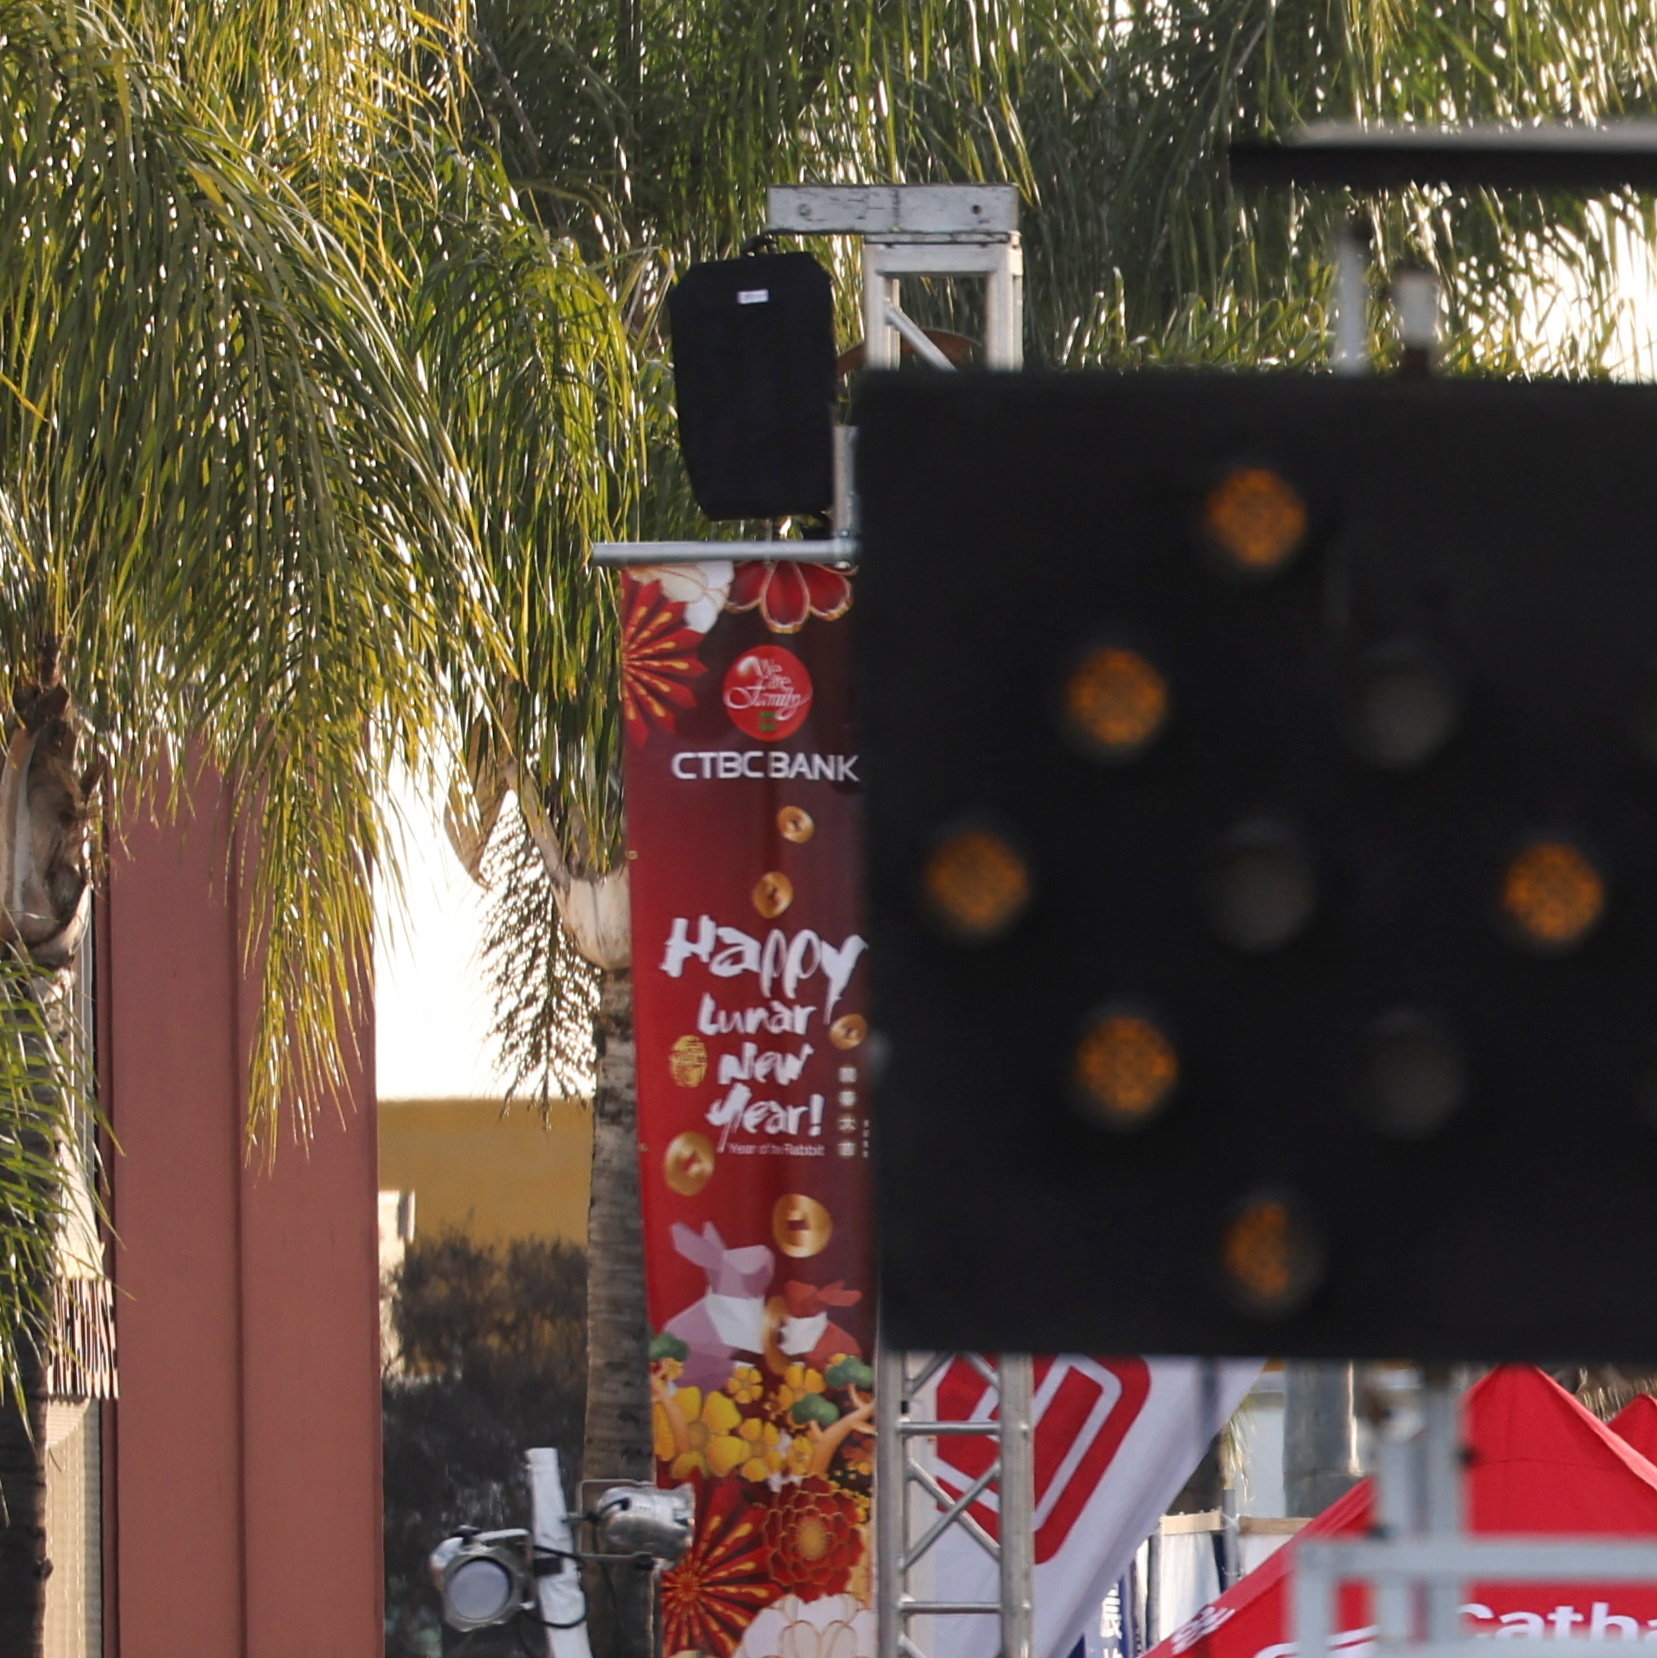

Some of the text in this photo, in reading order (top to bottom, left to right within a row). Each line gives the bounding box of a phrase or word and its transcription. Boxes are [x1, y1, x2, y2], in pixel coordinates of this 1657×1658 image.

[671, 751, 861, 782] CTBC BANK
[660, 914, 869, 1025] Happy
[698, 993, 818, 1036] Lunar
[718, 1042, 815, 1086] New
[705, 1082, 826, 1154] Year!
